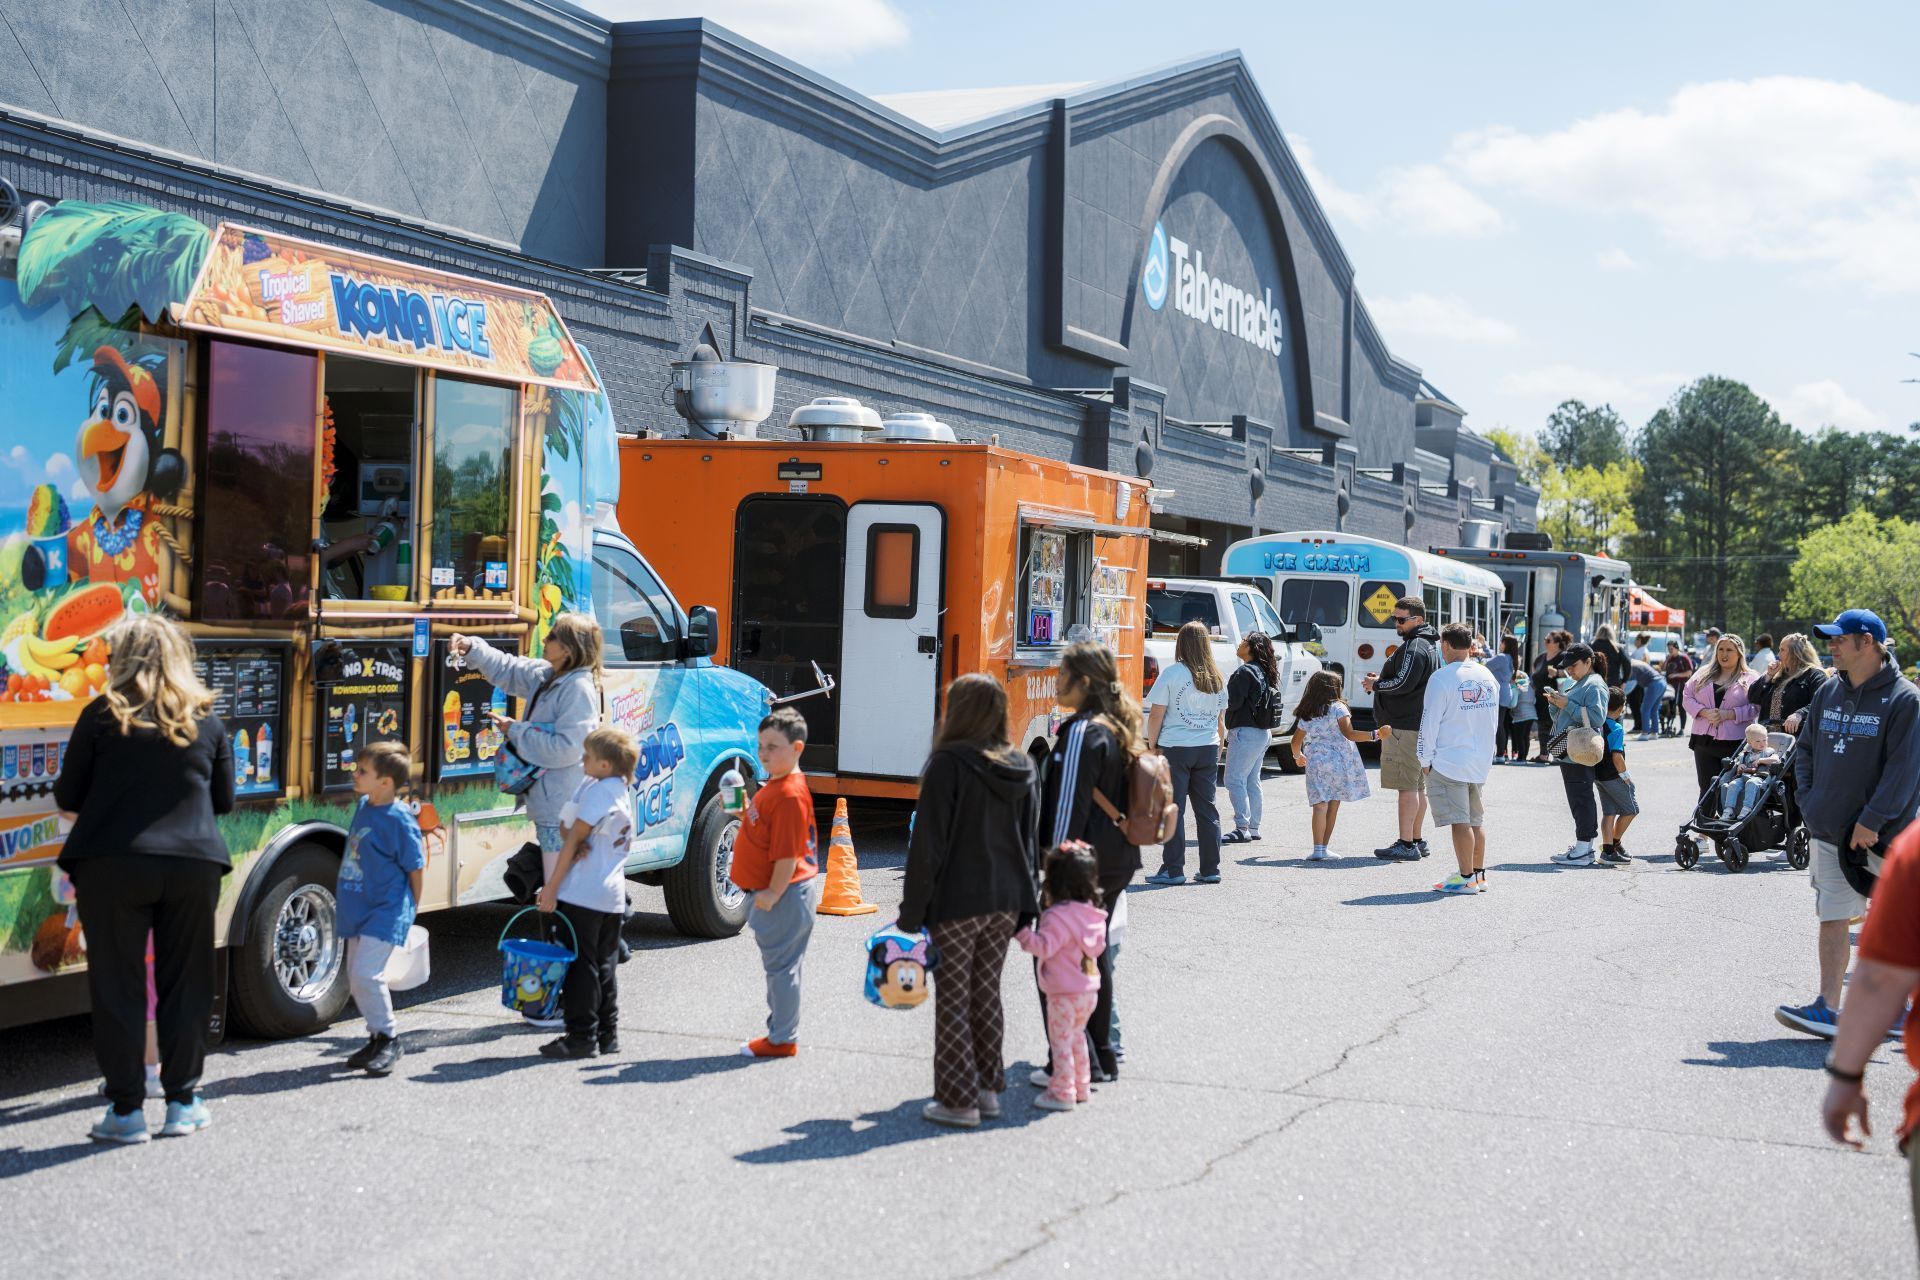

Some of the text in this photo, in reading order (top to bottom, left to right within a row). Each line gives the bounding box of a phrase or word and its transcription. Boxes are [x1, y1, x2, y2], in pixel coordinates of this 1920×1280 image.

[260, 270, 310, 299] Tropical
[1170, 236, 1282, 357] Tabernacle
[282, 299, 326, 324] Shaved
[330, 273, 491, 358] KONA ICE
[49, 549, 62, 570] K
[1264, 552, 1370, 573] ICE CREAM
[1033, 615, 1050, 640] OPEN
[361, 658, 403, 681] X-TRAS
[612, 687, 645, 723] Tropical
[632, 721, 684, 790] ONA
[636, 773, 675, 837] ICE
